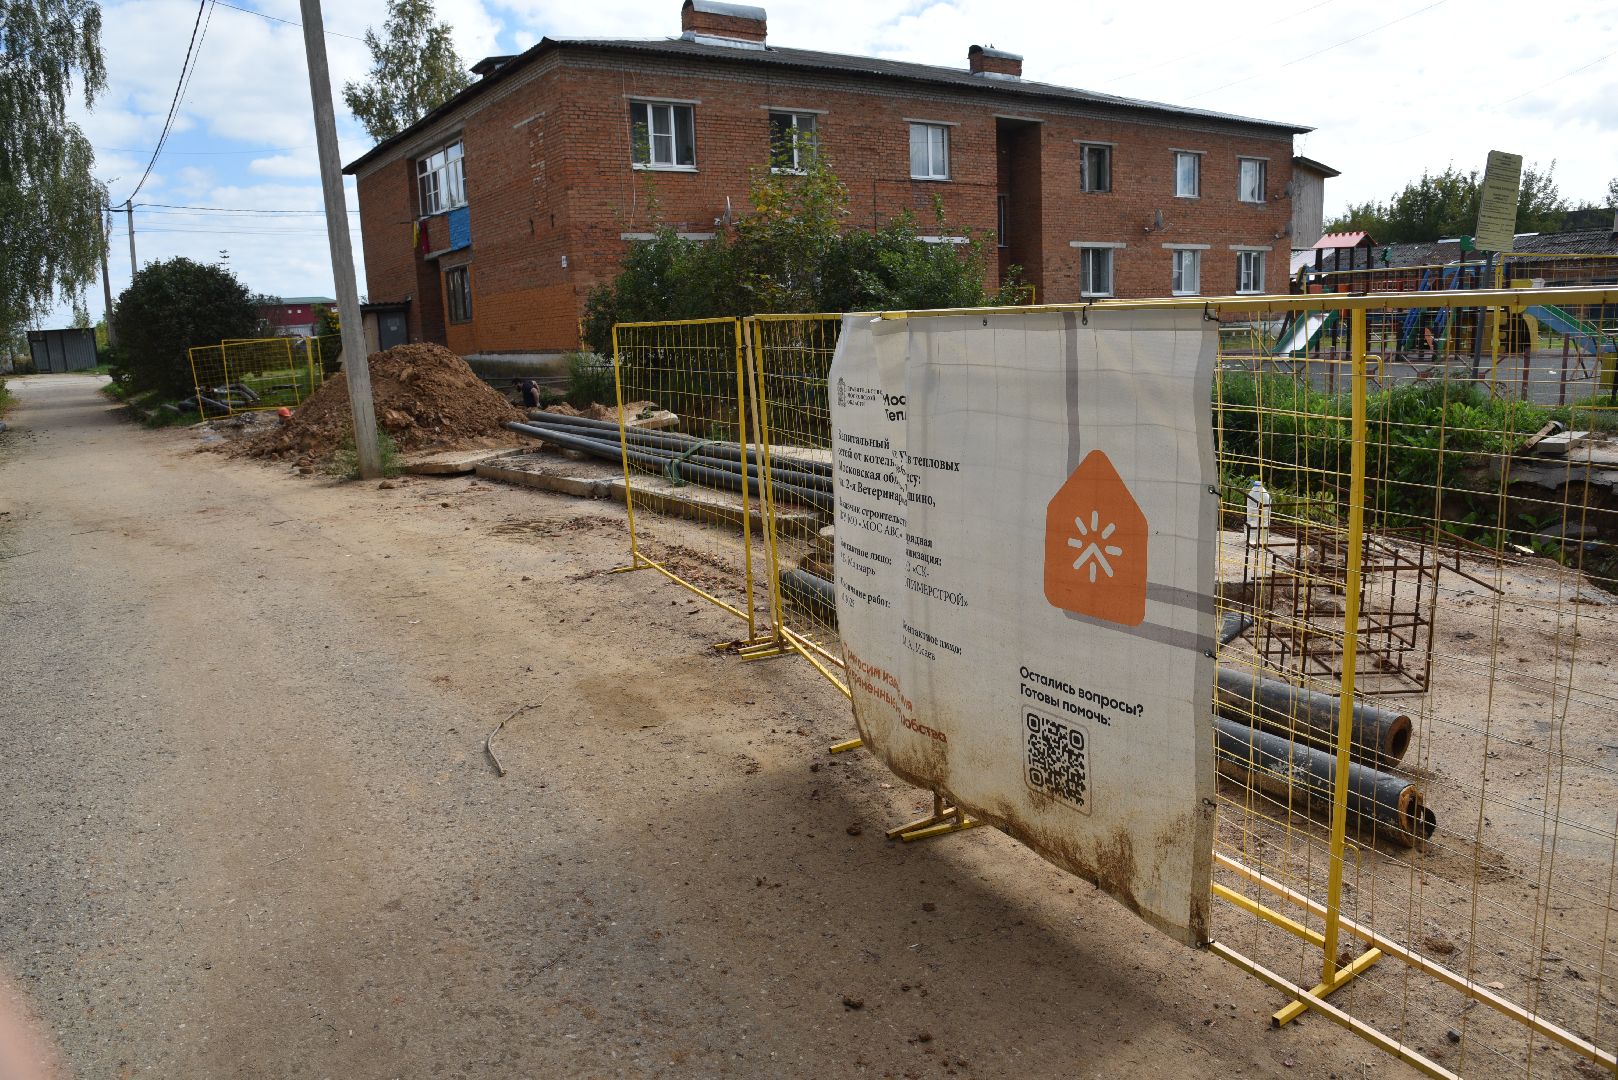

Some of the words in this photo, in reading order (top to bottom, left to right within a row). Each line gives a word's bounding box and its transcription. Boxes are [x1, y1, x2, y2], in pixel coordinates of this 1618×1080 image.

[913, 457, 960, 472] тепловых
[867, 594, 891, 609] работ:
[1020, 666, 1076, 695] Остались
[1078, 687, 1144, 718] вопросы?
[1020, 683, 1060, 708] Готовы
[1062, 700, 1111, 726] помочь:
